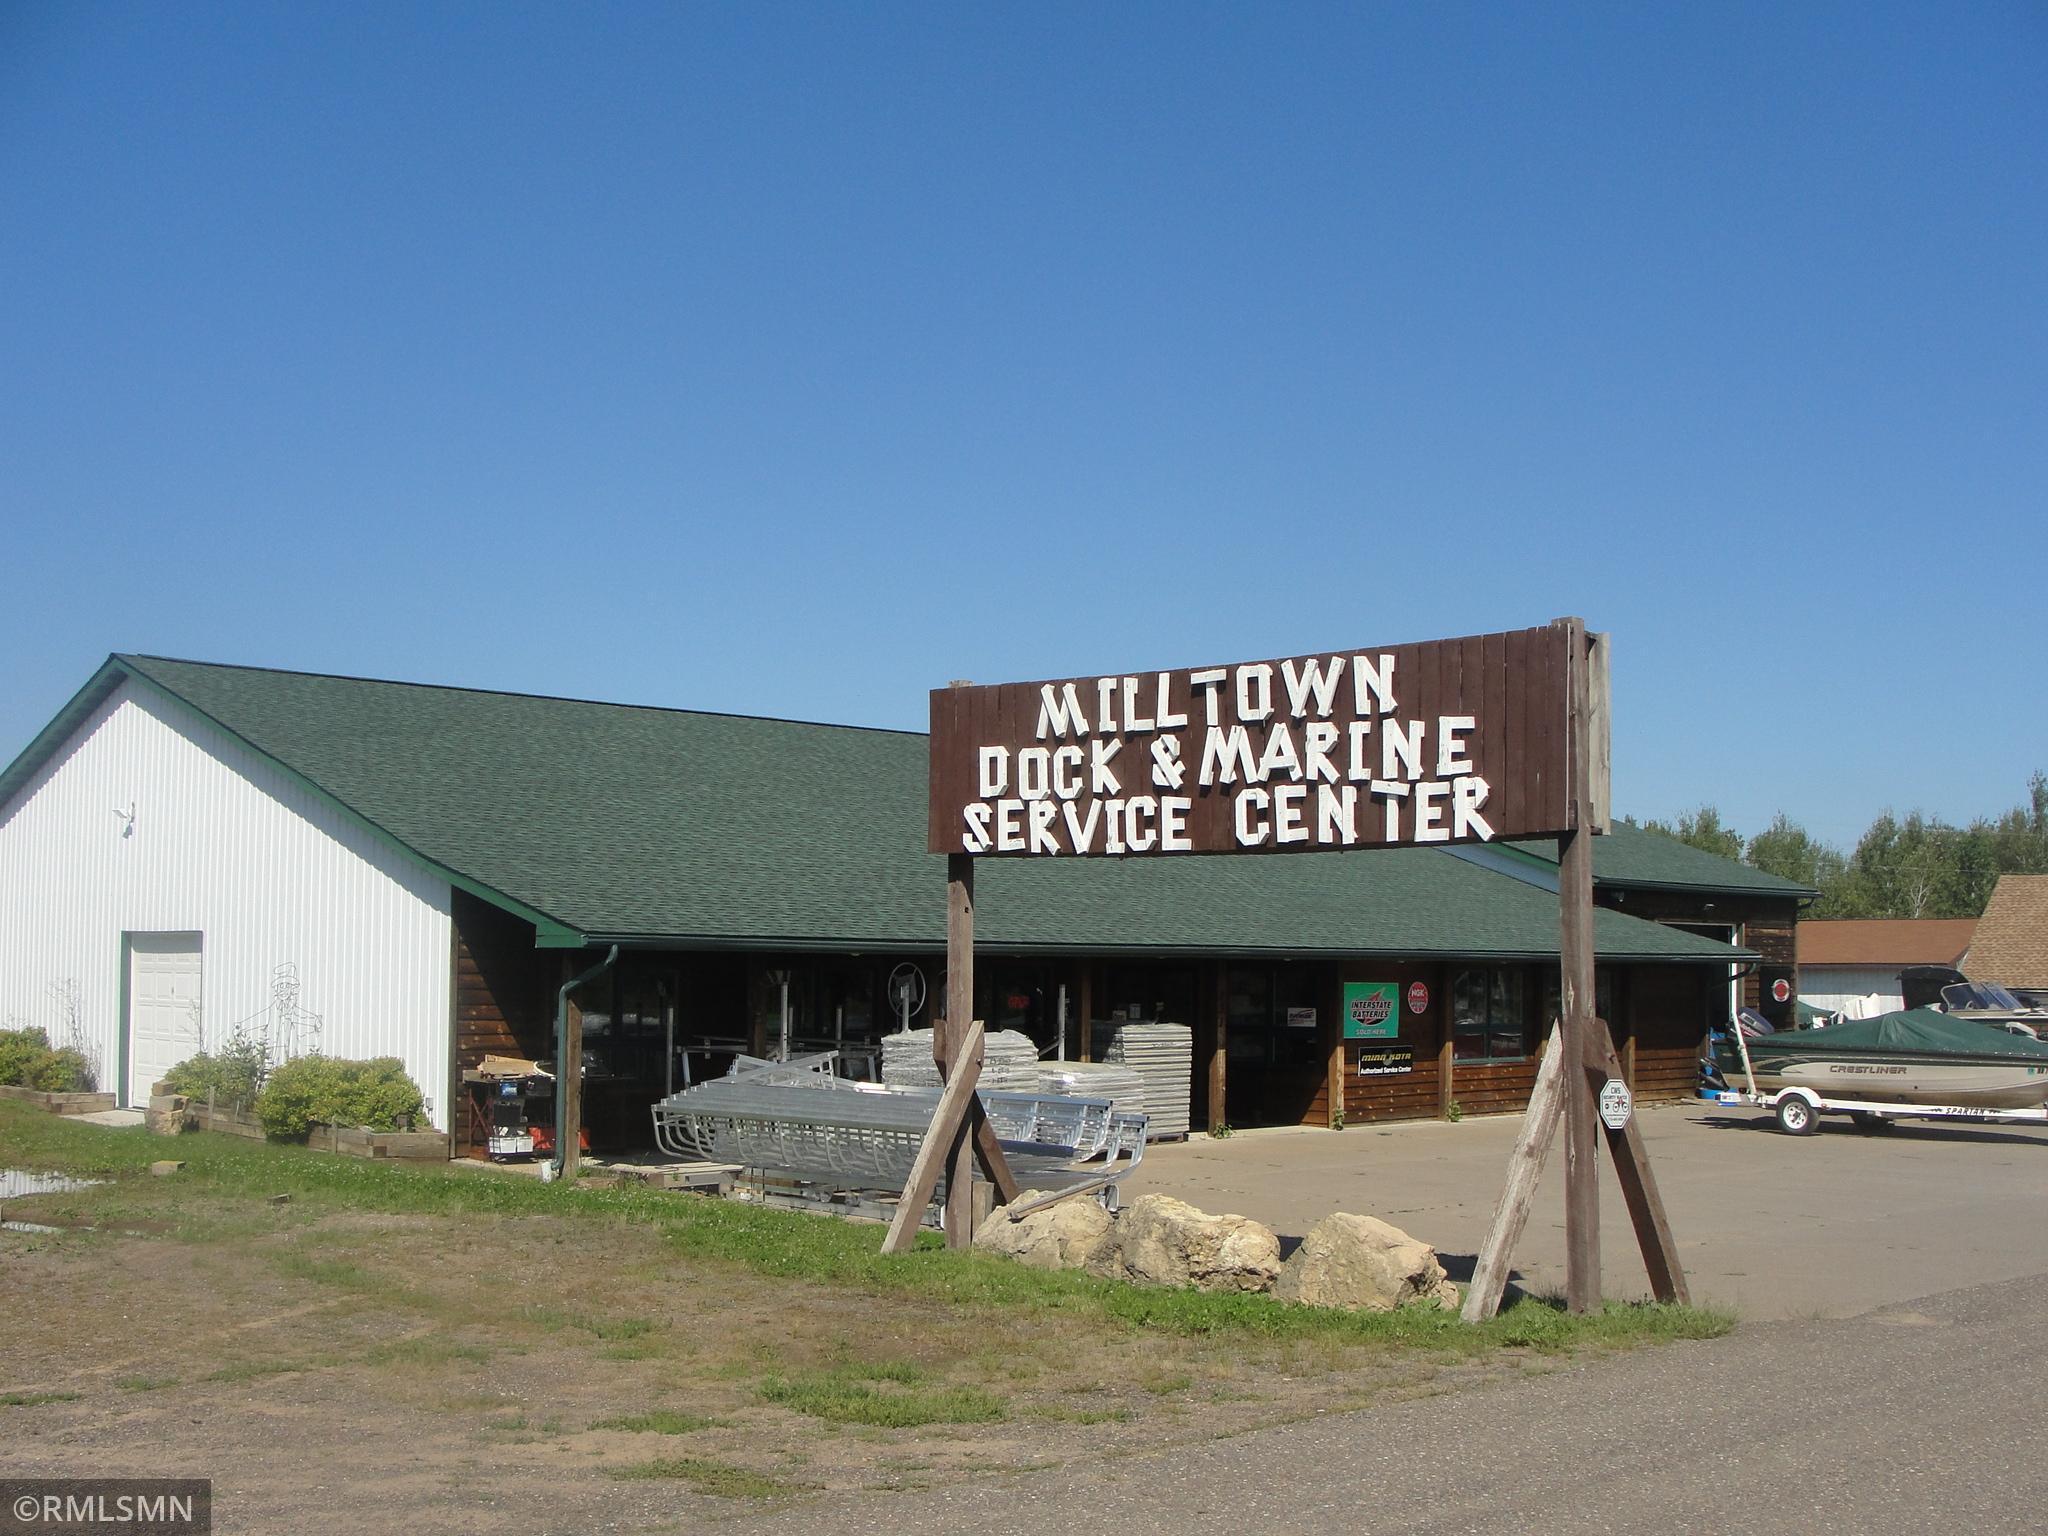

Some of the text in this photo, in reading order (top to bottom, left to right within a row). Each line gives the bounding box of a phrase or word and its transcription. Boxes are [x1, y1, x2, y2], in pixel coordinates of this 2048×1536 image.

[1036, 654, 1398, 739] MILLTOWN
[979, 716, 1475, 801] DOCK & MARINE
[962, 777, 1495, 856] SERVICE CENTER
[1351, 1001, 1392, 1009] INTERSTATE
[1352, 1010, 1389, 1018] BATTERIES
[1830, 1065, 1907, 1074] CRESTLINER
[1946, 1107, 1985, 1115] SPARTAN
